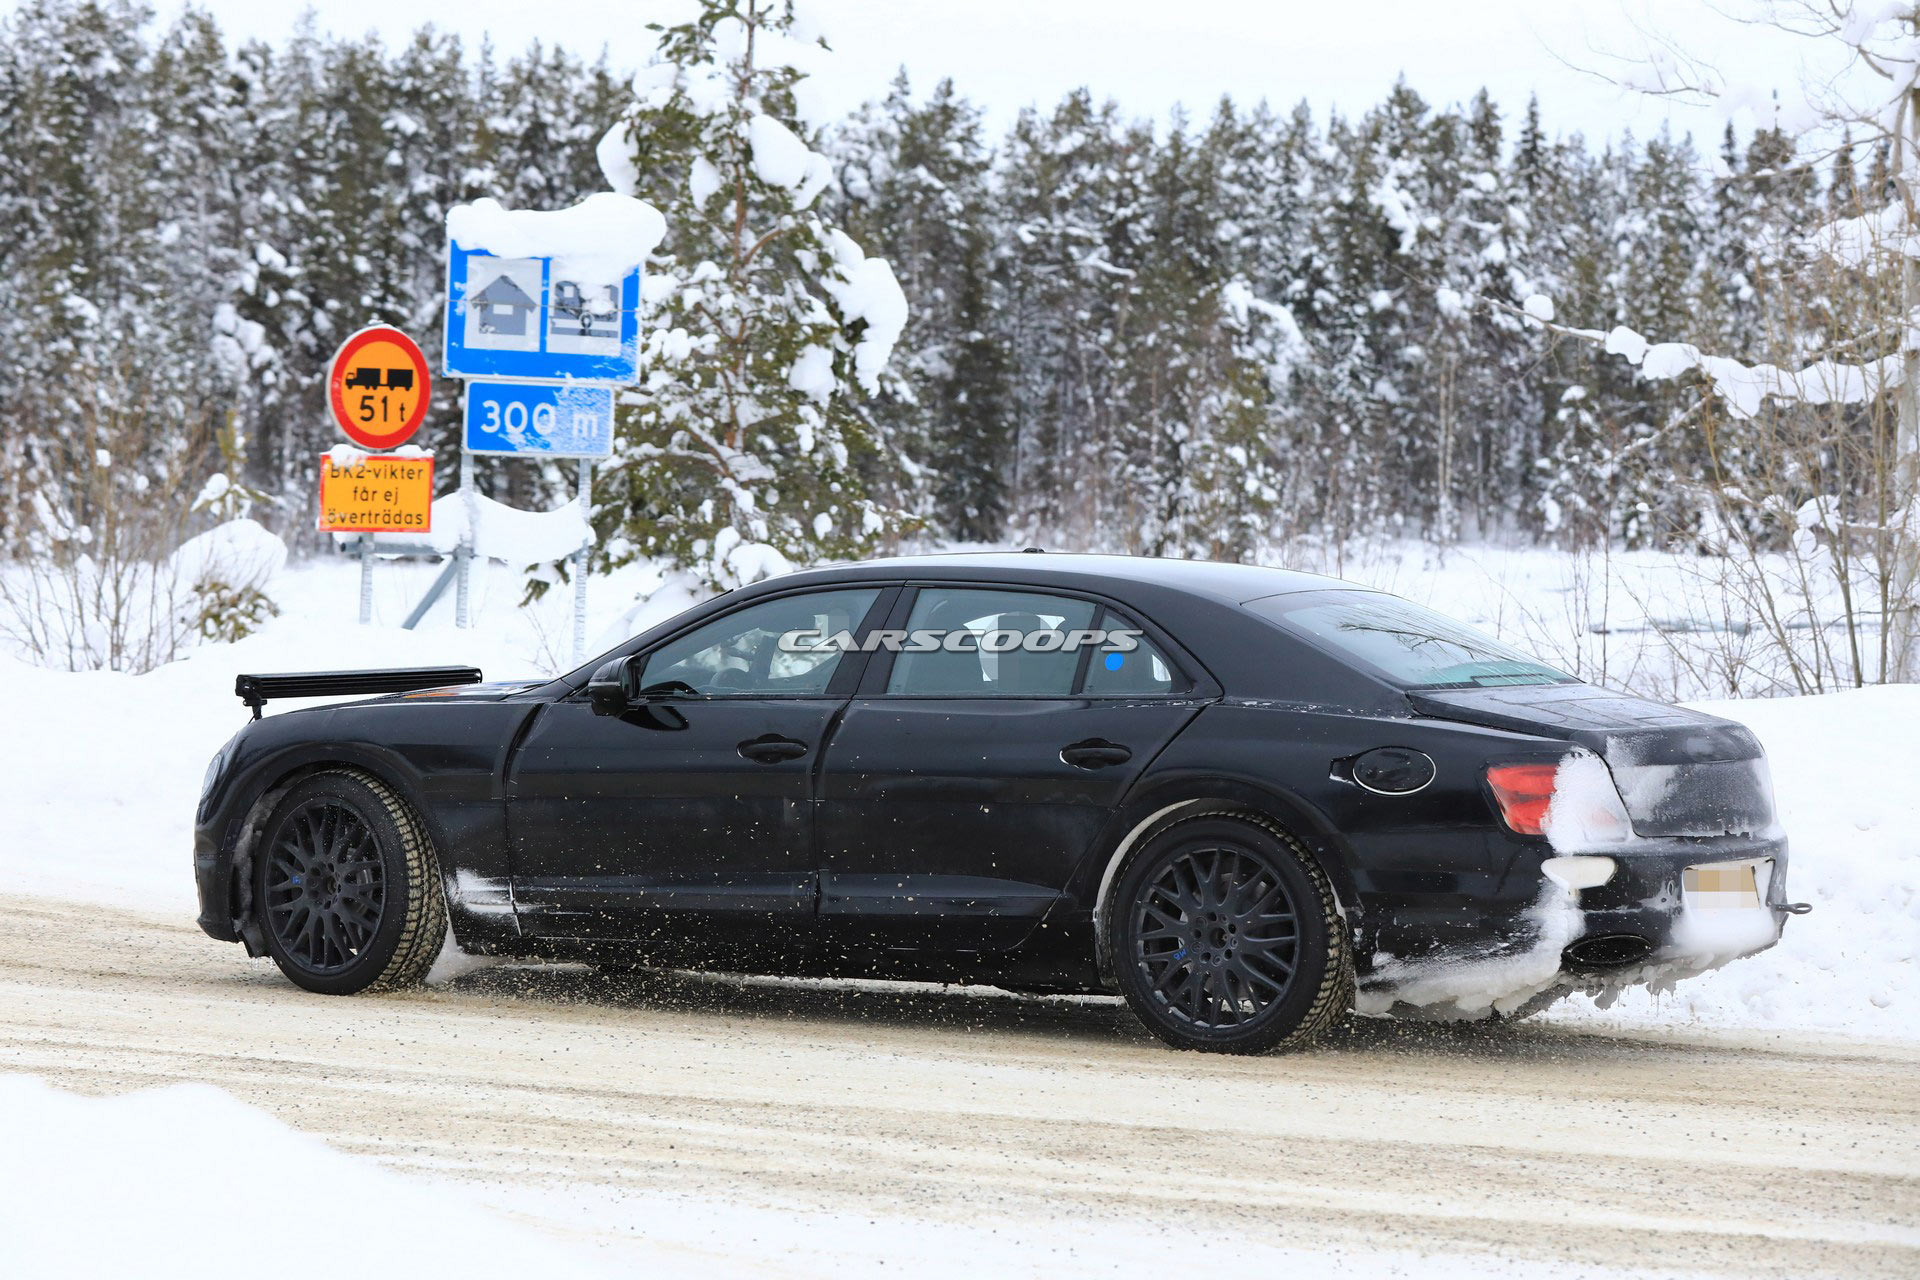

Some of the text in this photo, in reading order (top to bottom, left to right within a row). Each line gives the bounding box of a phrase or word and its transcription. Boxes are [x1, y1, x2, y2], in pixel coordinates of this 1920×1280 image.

[359, 395, 406, 422] 51 t
[481, 400, 599, 437] 300 m
[352, 486, 399, 505] får ej
[327, 508, 424, 525] överträdas
